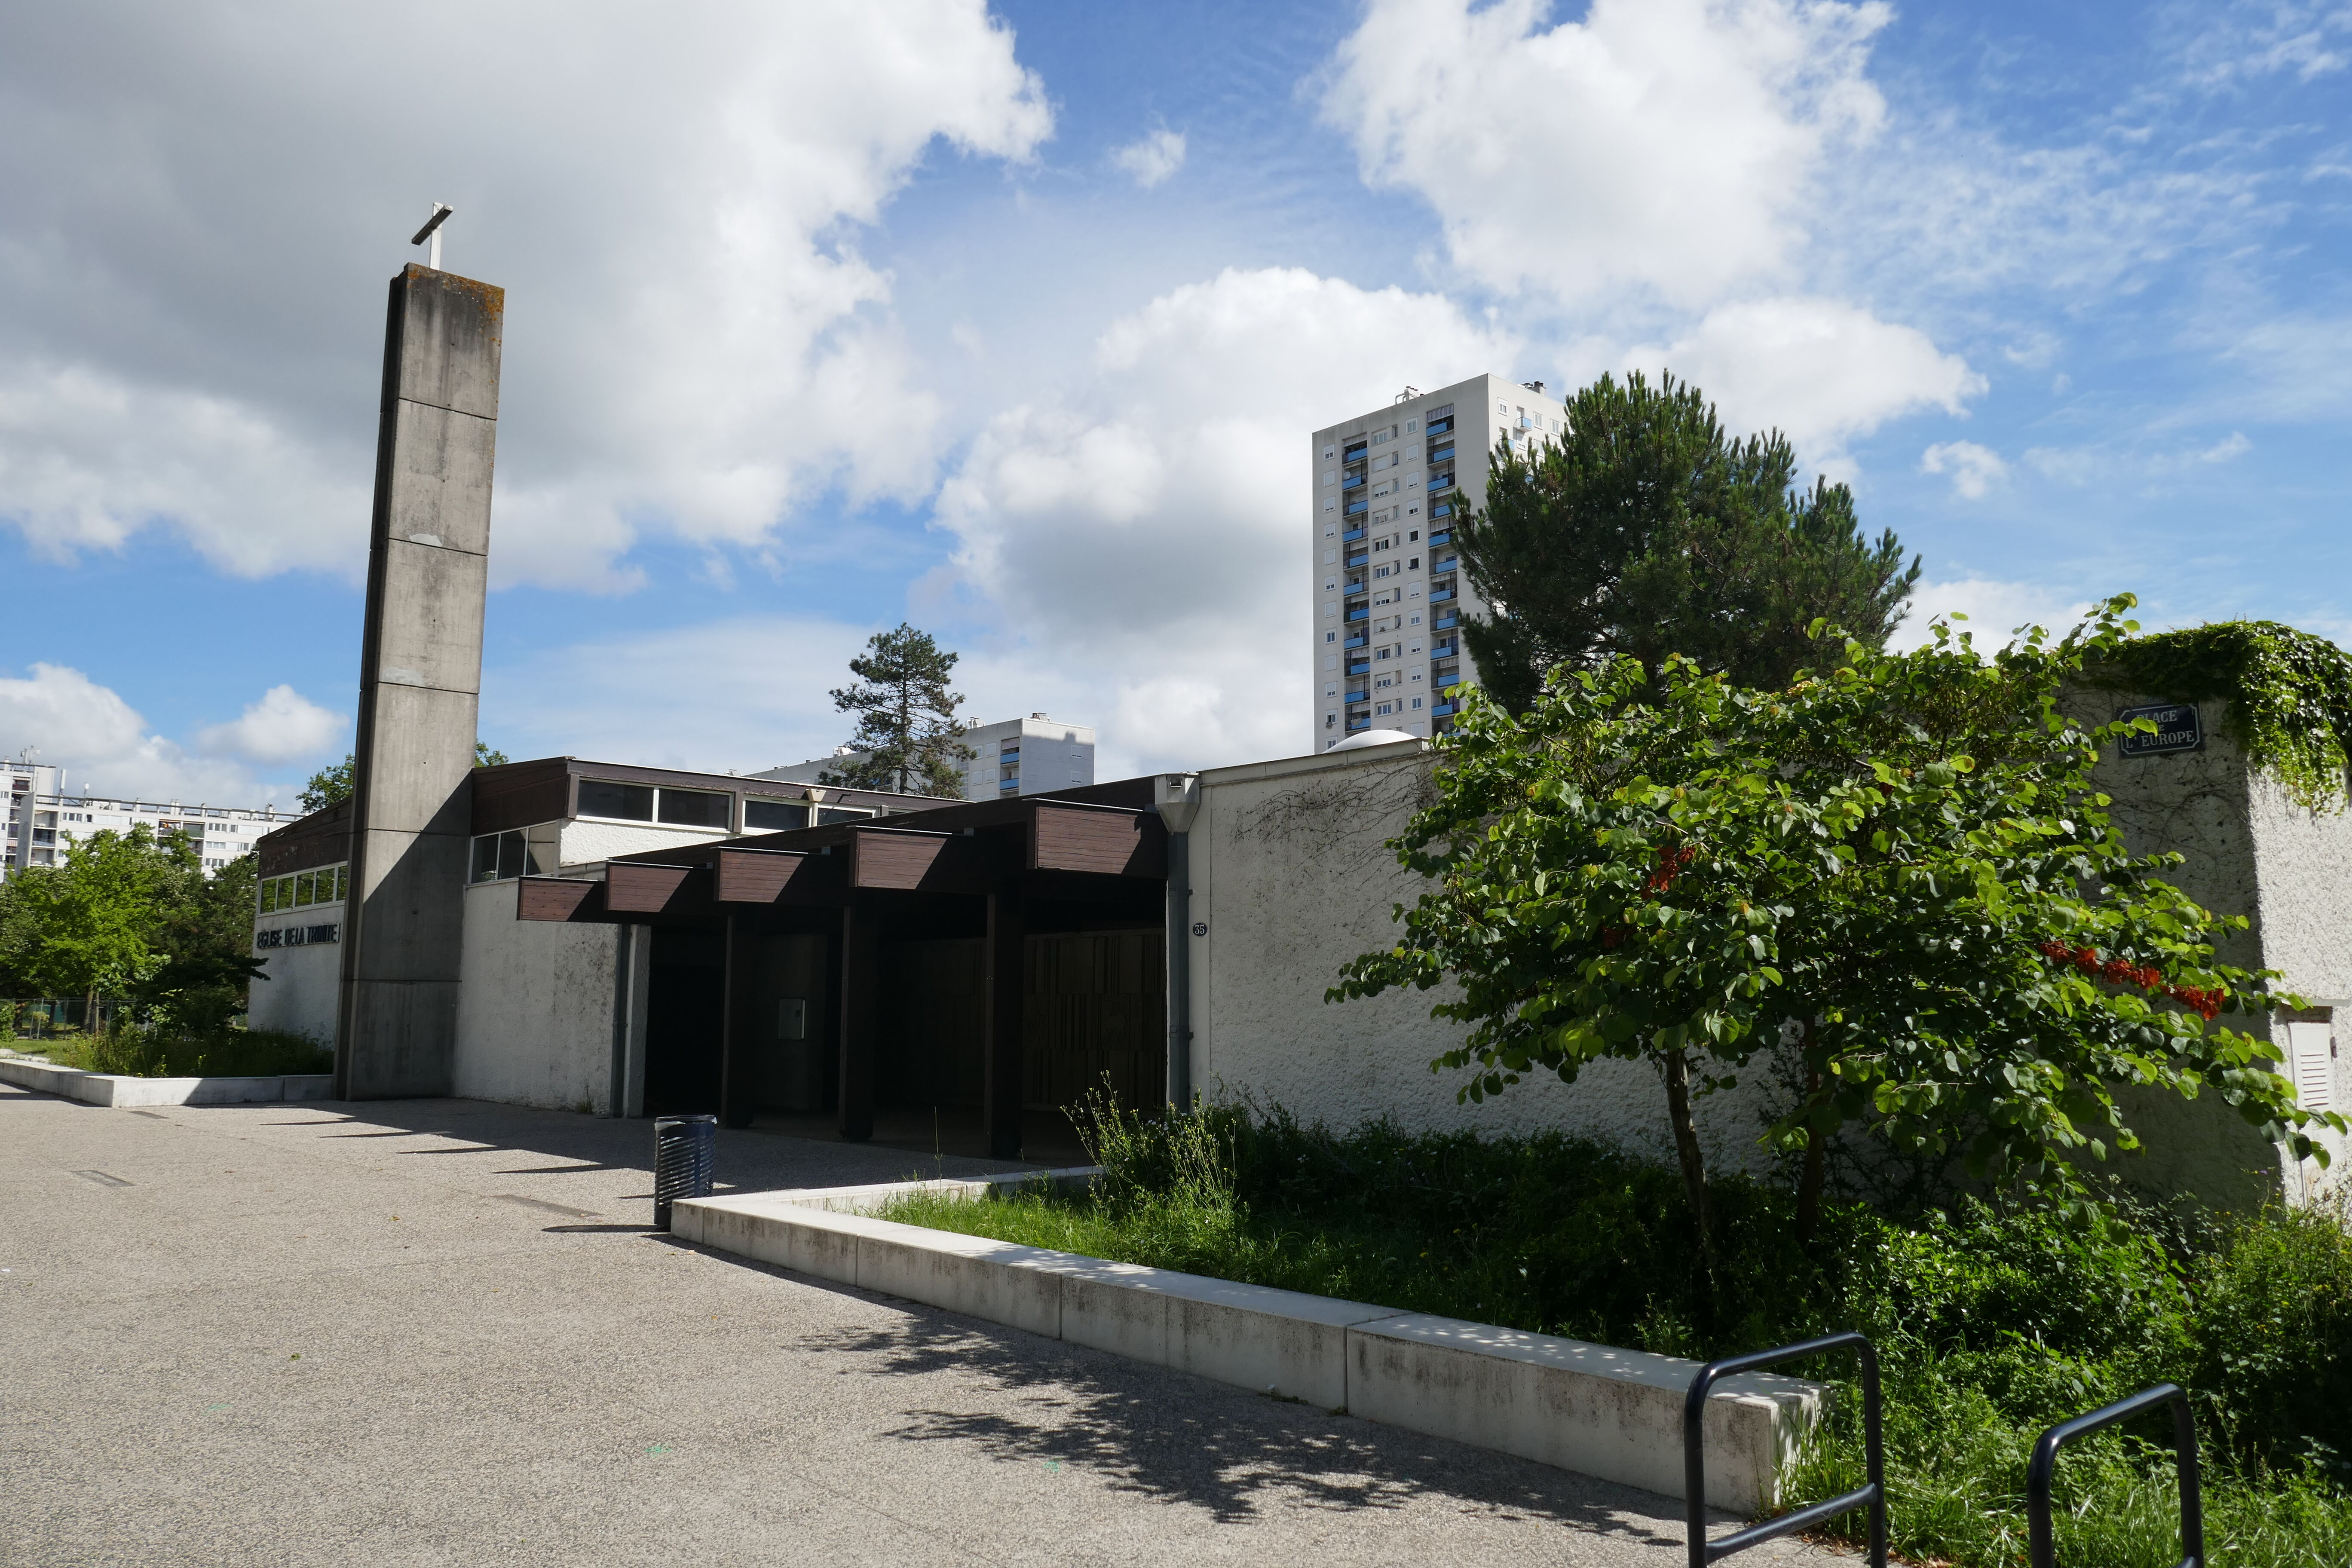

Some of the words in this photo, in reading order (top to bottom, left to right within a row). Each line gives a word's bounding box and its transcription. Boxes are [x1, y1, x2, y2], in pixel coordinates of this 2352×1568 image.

[1195, 925, 1204, 934] 35
[285, 928, 295, 945] DE
[295, 928, 304, 944] LA
